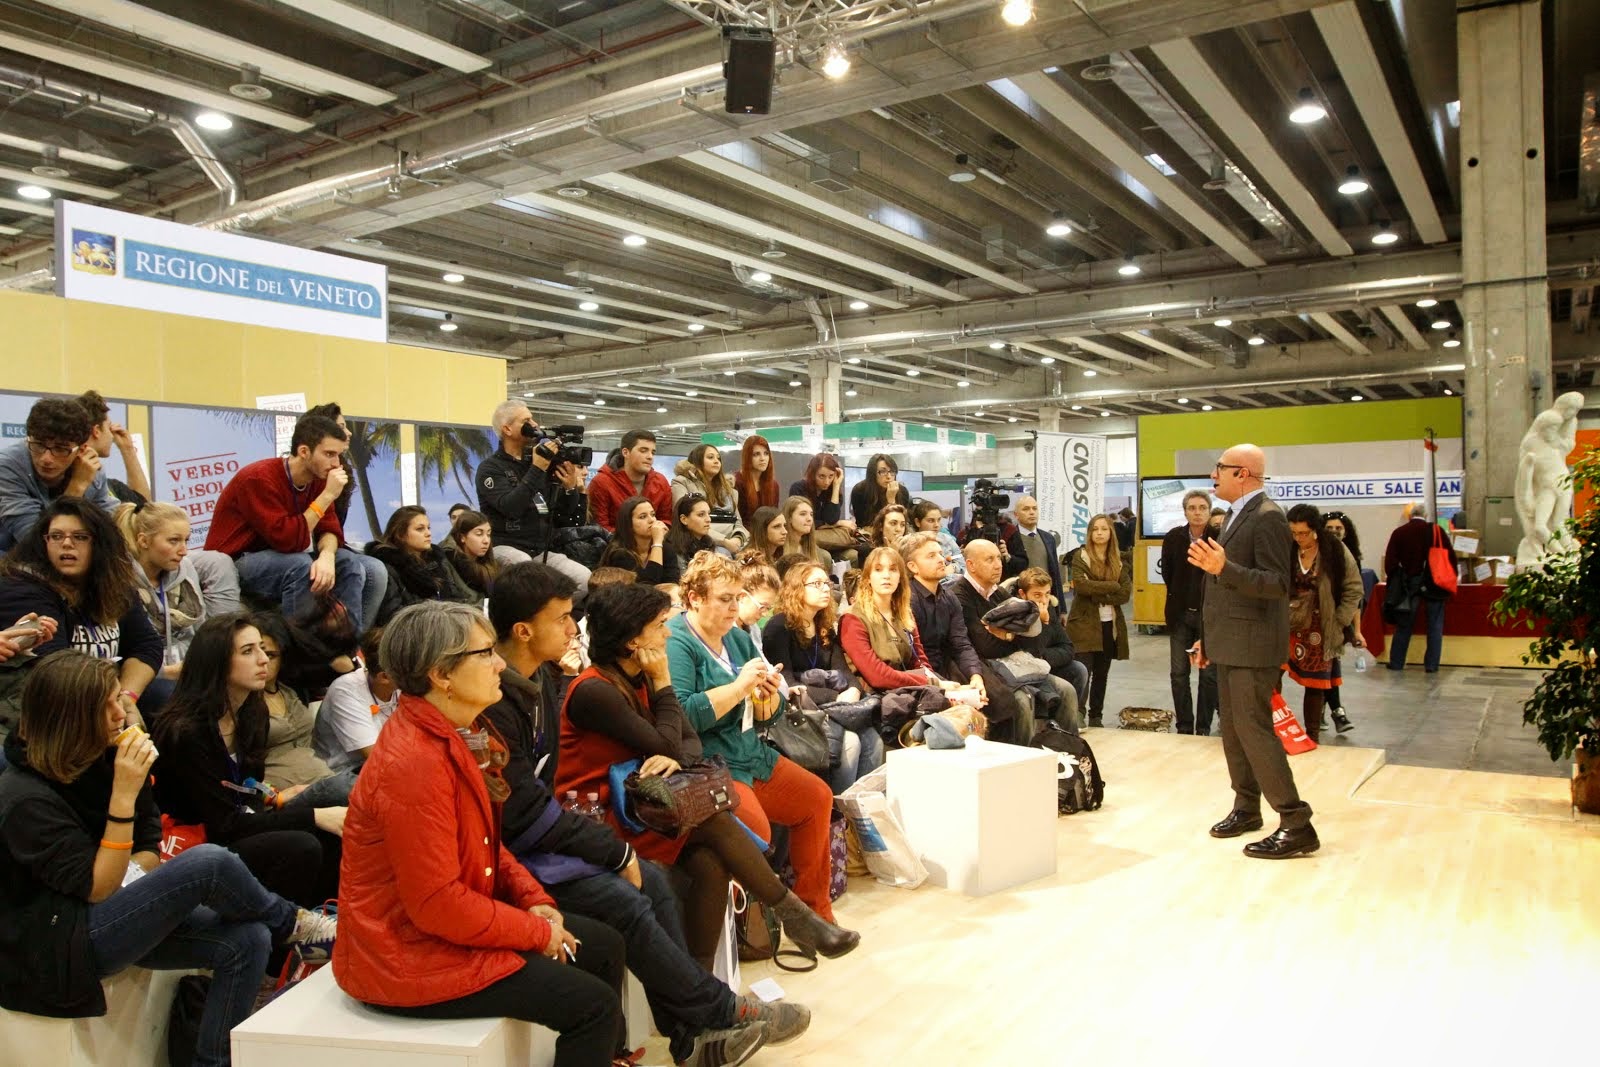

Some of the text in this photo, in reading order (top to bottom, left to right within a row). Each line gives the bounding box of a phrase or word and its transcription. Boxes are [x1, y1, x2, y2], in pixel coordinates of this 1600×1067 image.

[135, 252, 374, 310] REGIONE DEL VENETO
[6, 426, 27, 437] REG
[168, 460, 239, 483] VERSO
[172, 481, 224, 502] L'ISOL
[1071, 442, 1090, 544] CNOSFAP
[180, 500, 215, 518] HE
[190, 525, 210, 536] Regio
